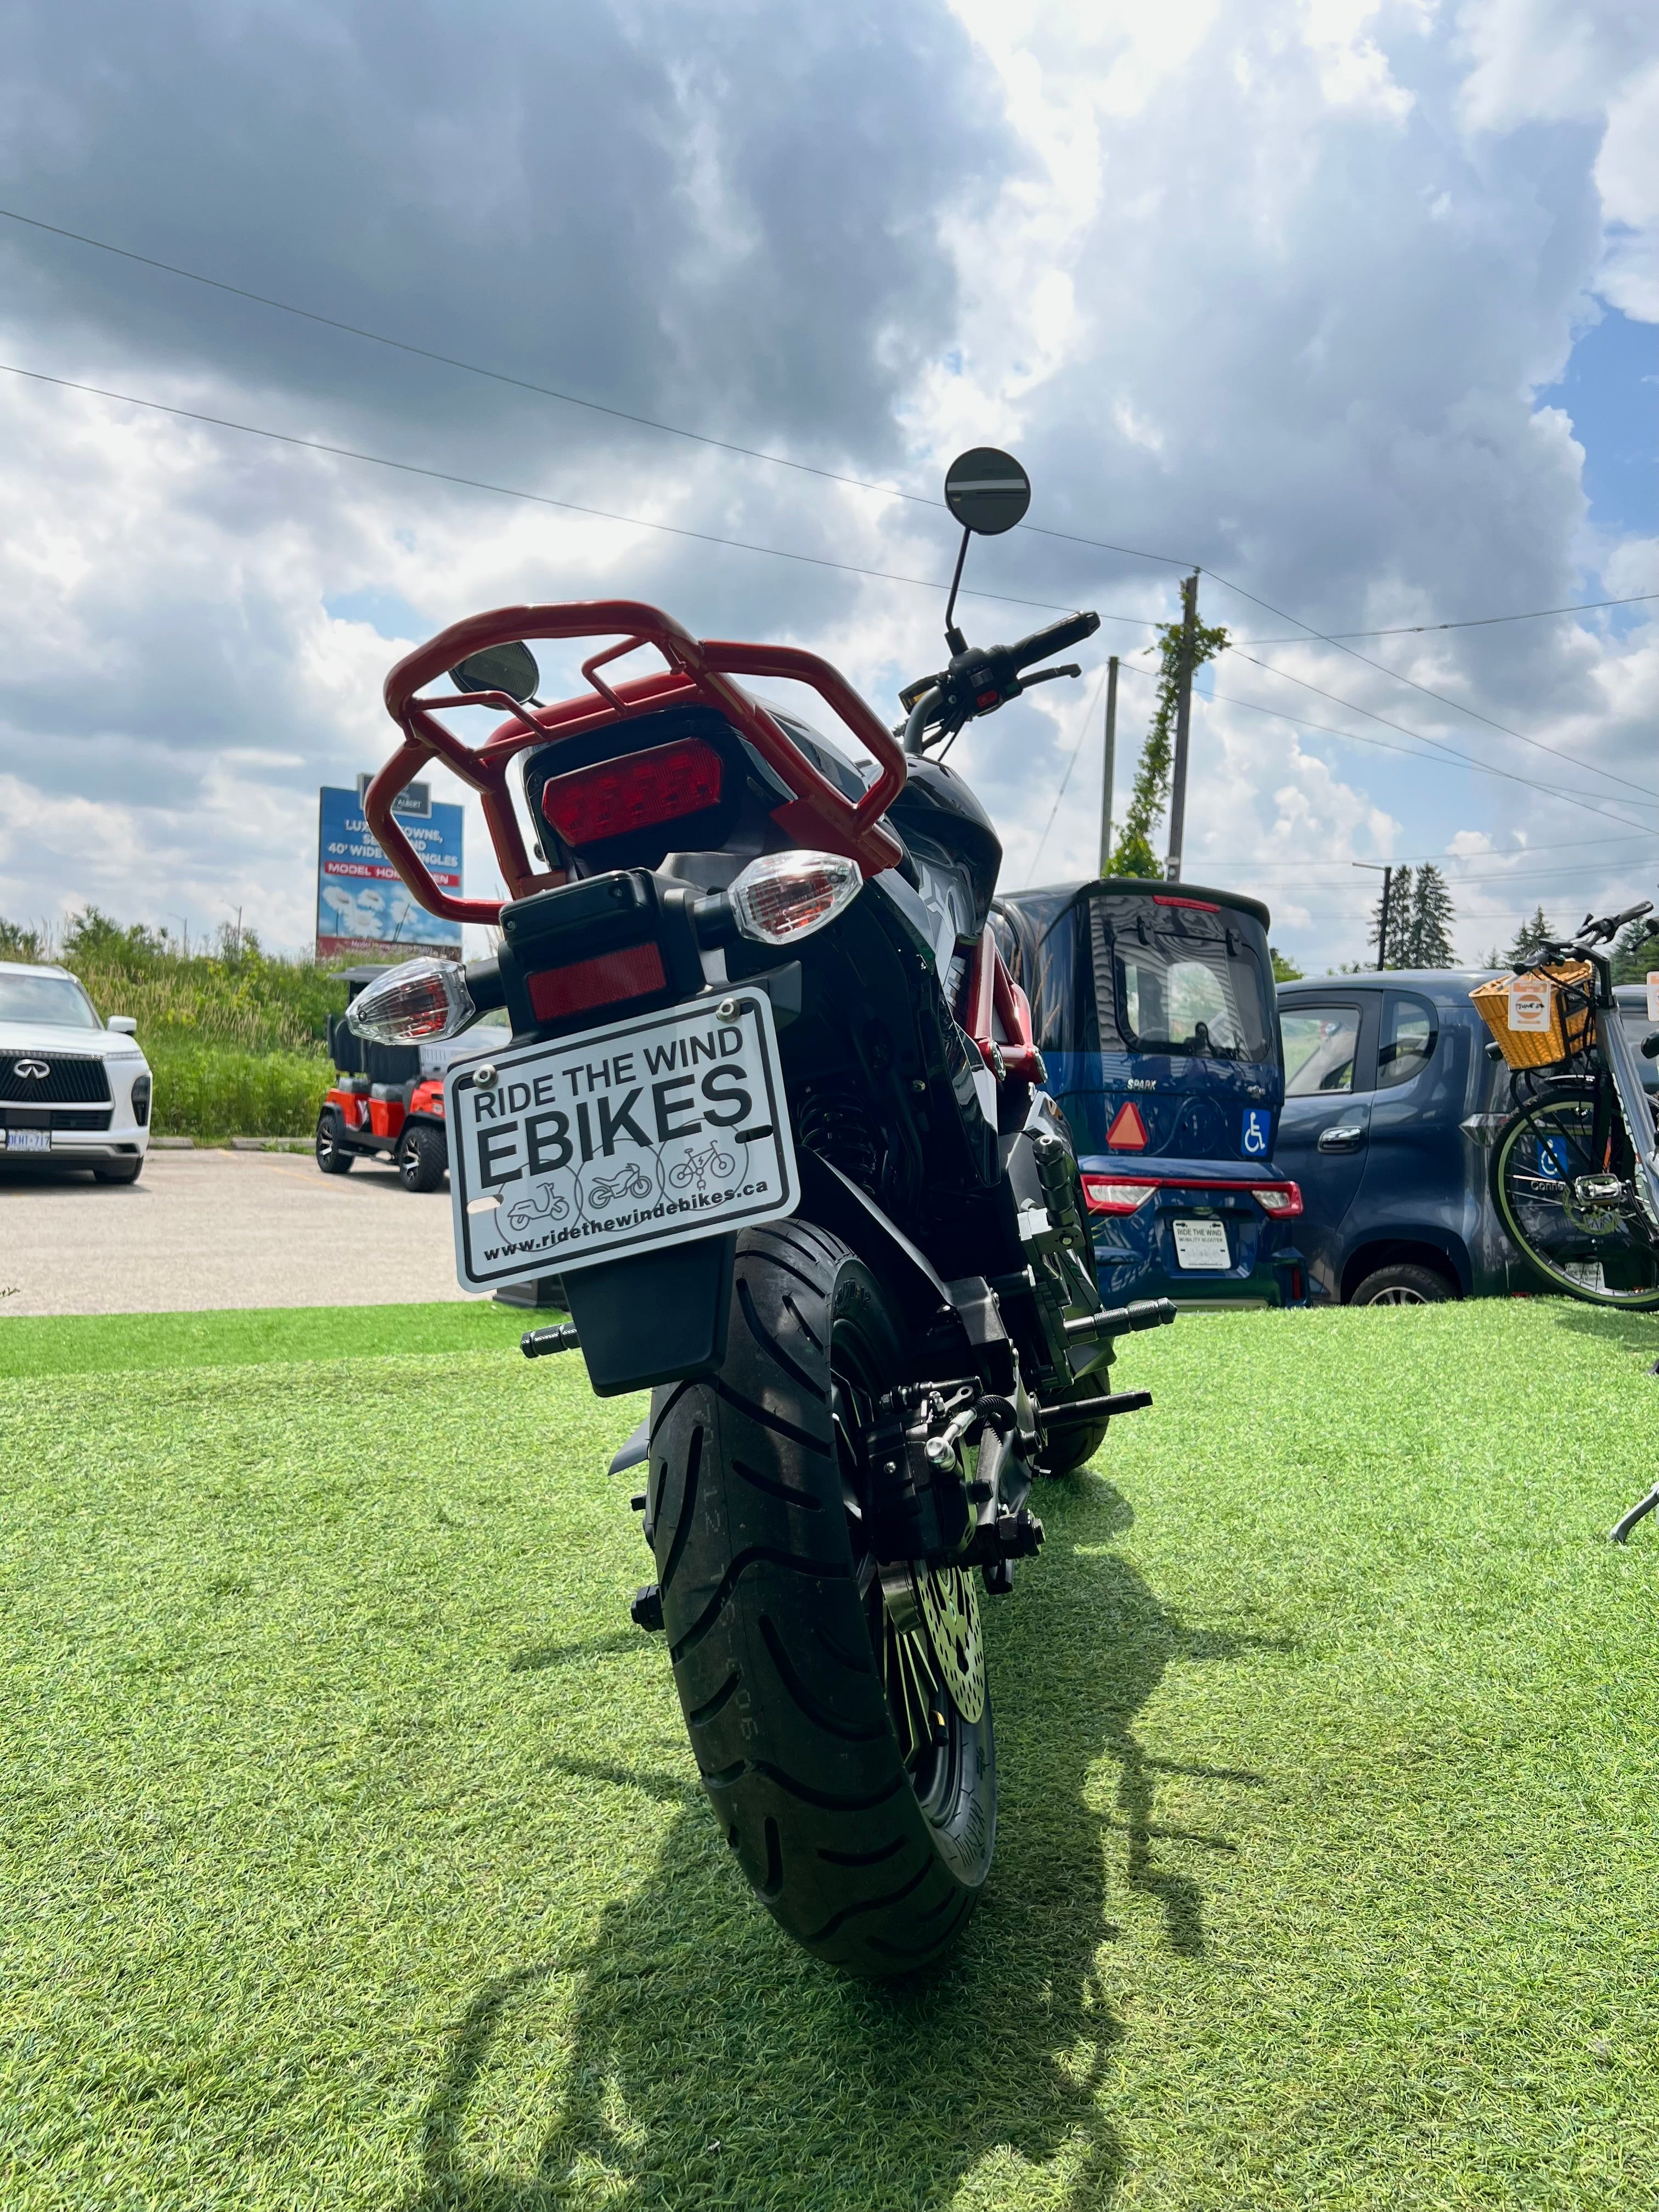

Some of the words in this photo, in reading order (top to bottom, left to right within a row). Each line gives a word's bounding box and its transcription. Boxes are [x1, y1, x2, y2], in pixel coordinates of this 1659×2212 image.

[401, 826, 443, 844] OWNS,
[349, 844, 383, 859] WIDE
[328, 864, 372, 876] MODEL
[474, 1074, 556, 1122] RIDE
[563, 1052, 635, 1096] THE
[644, 1026, 743, 1075] WIND
[1127, 1079, 1156, 1091] SPARK
[477, 1064, 752, 1189] EBIKES
[484, 1181, 768, 1260] www.ridethewindebikes.ca
